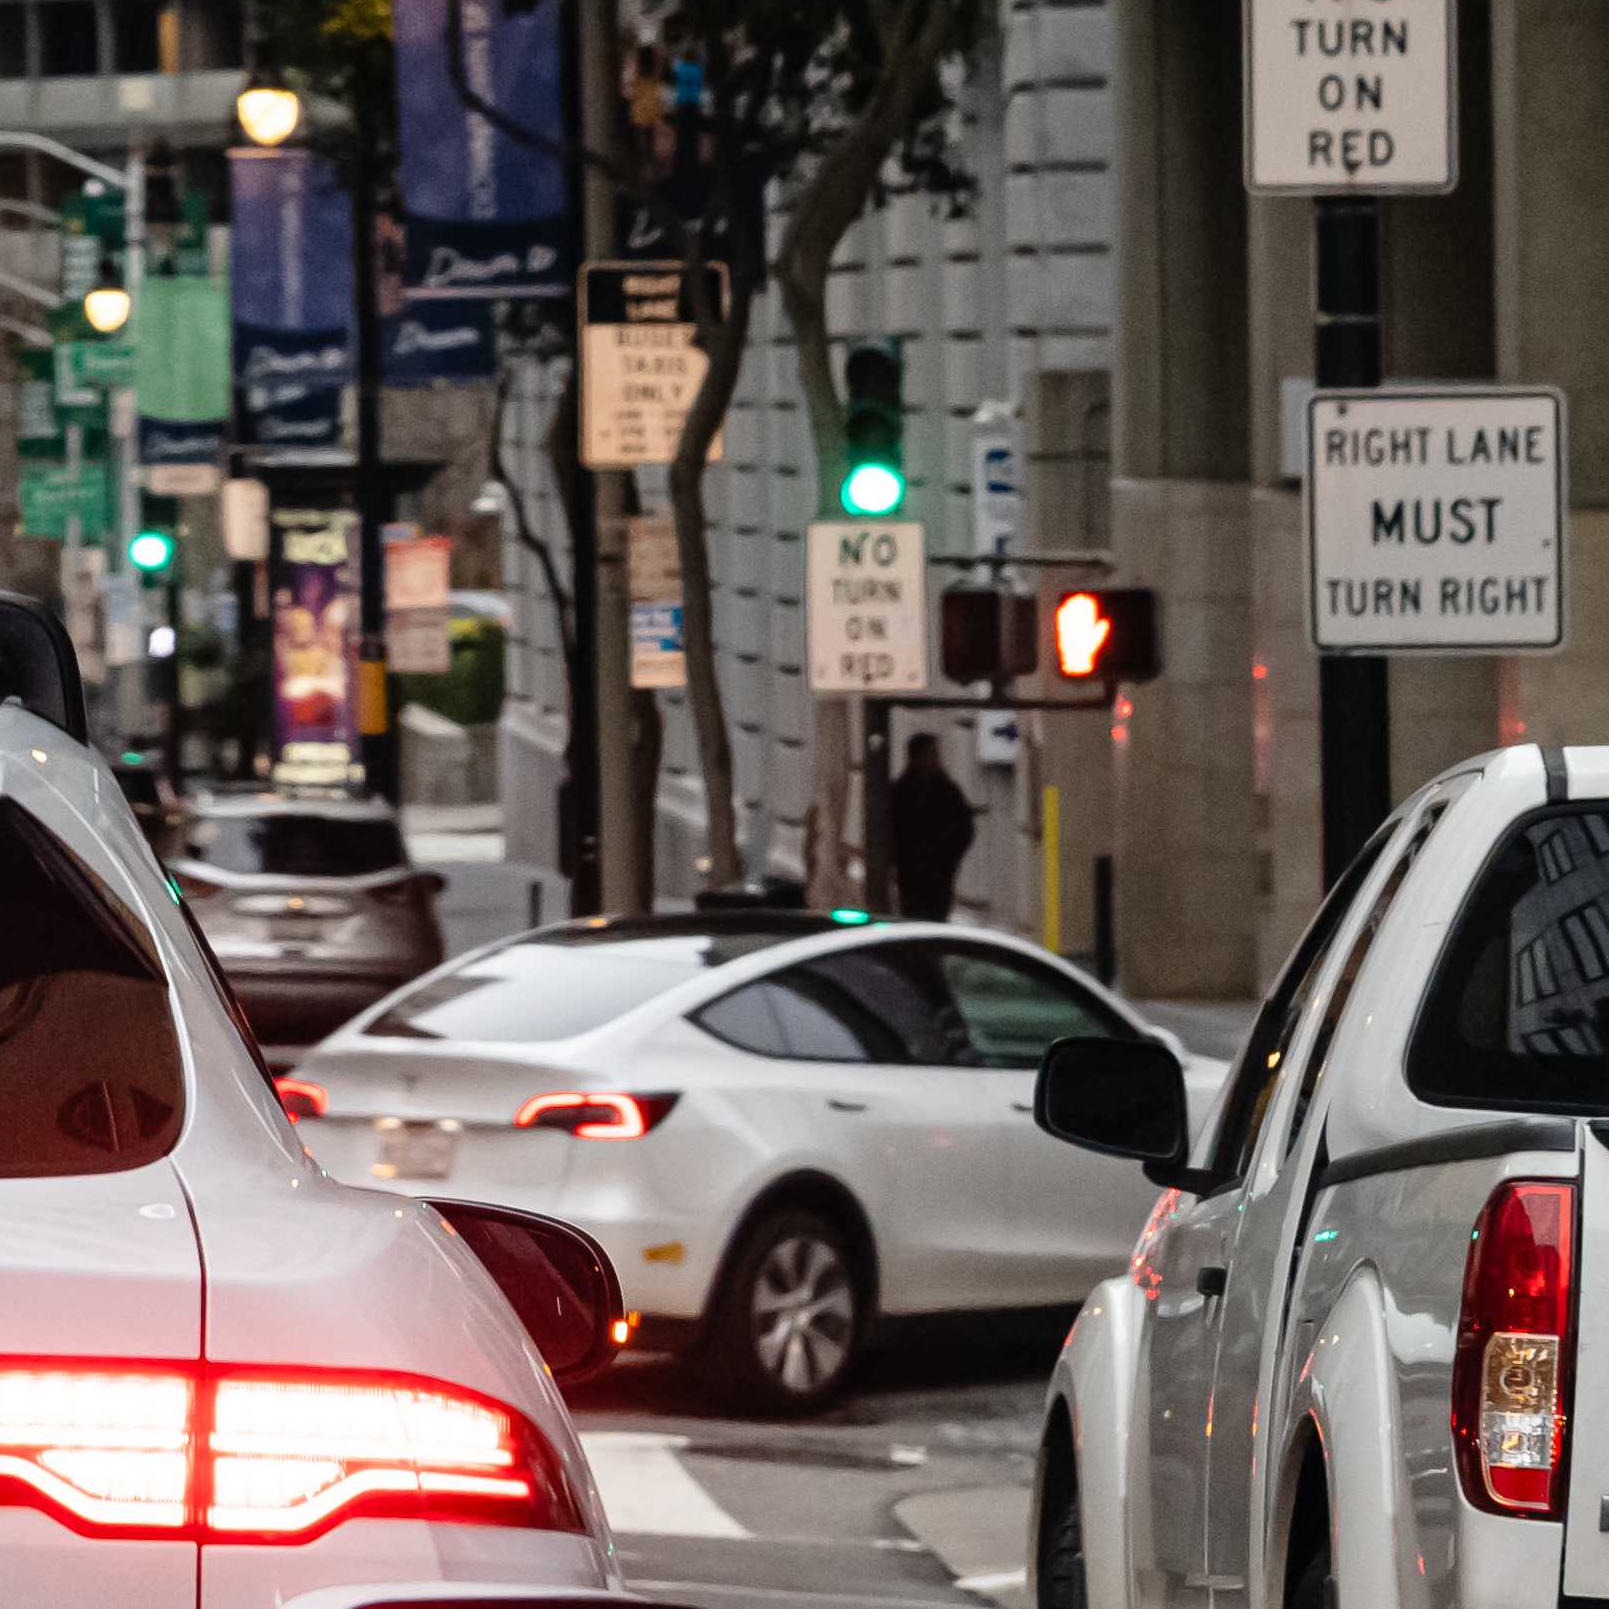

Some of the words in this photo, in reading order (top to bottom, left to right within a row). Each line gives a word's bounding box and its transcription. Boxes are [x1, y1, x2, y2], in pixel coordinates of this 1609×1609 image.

[1291, 18, 1409, 58] TURN
[1318, 74, 1384, 112] ON
[1308, 129, 1395, 168] RED
[1324, 427, 1433, 467] RIGHT
[1446, 425, 1546, 465] LANE
[1371, 497, 1503, 546] MUST
[838, 533, 898, 568] NO
[831, 577, 903, 605] TURN
[1326, 578, 1423, 617] TURN
[1439, 575, 1549, 616] RIGHT
[844, 616, 884, 642] ON
[839, 650, 896, 680] RED
